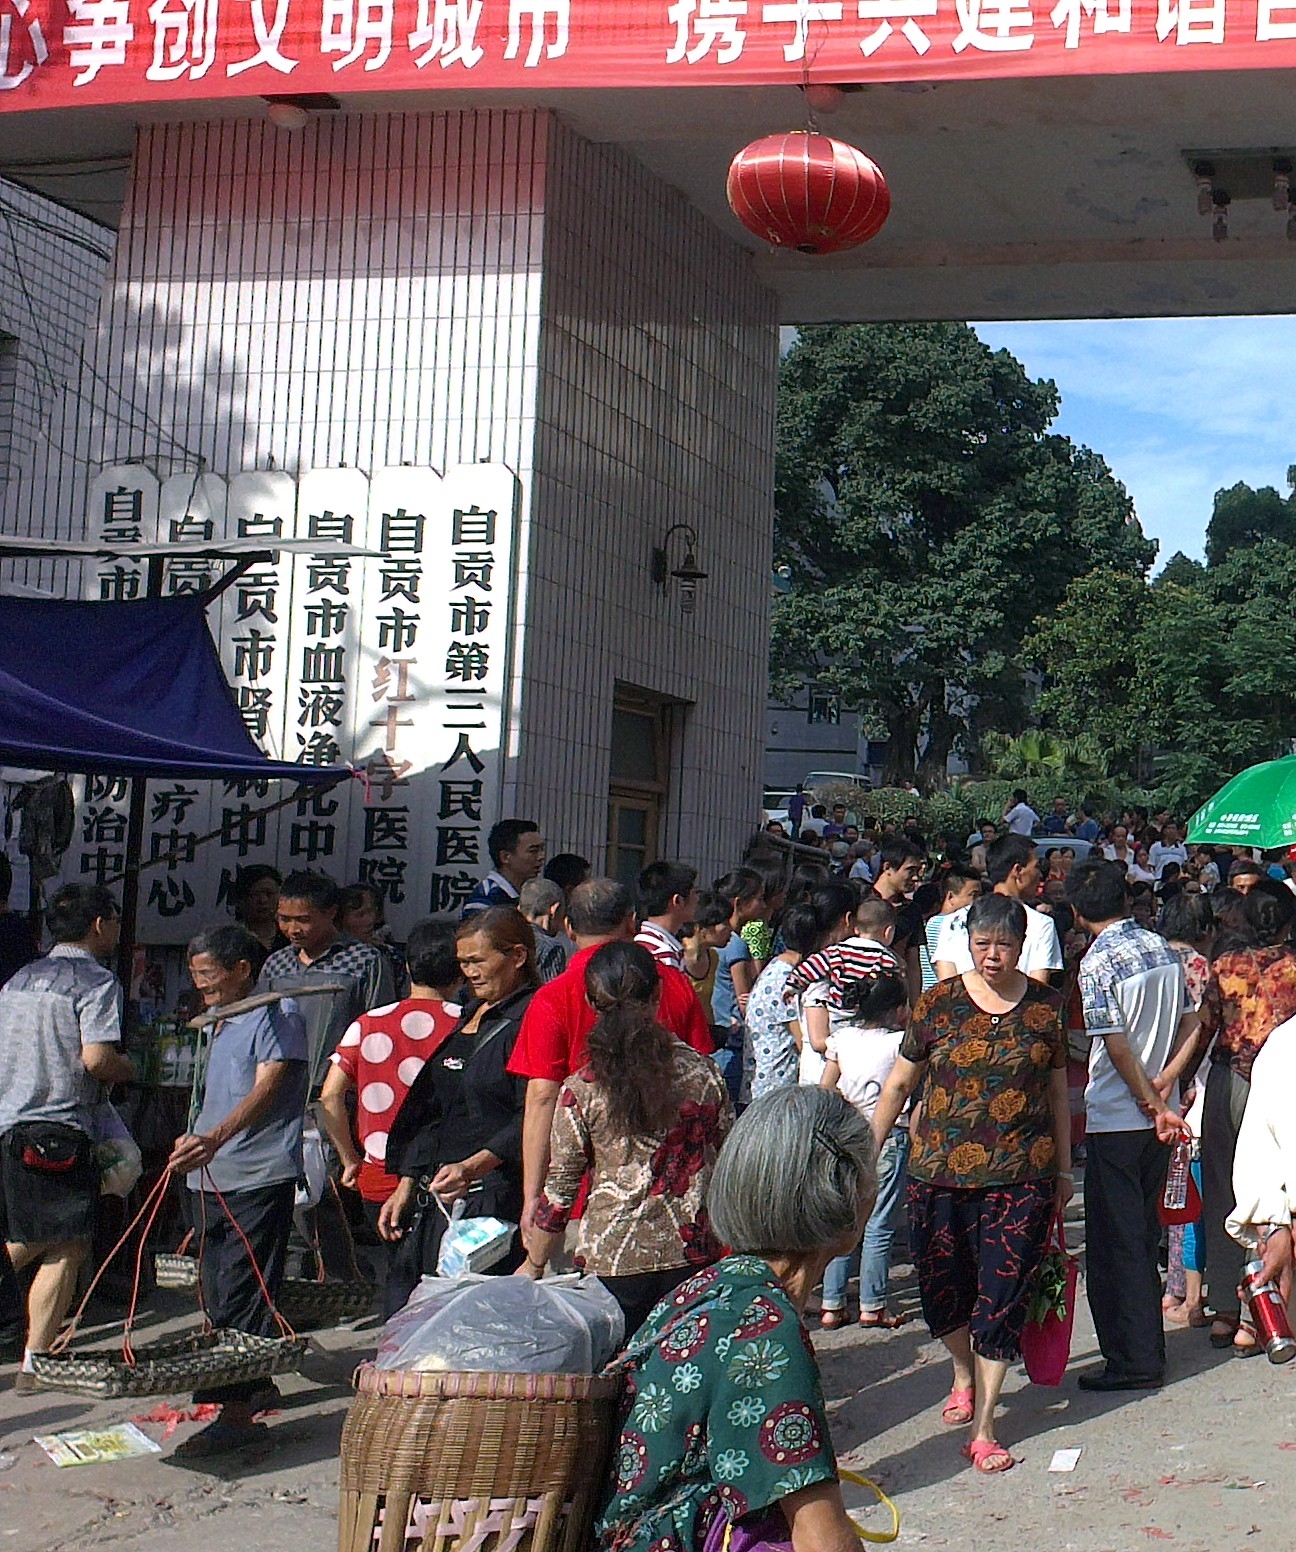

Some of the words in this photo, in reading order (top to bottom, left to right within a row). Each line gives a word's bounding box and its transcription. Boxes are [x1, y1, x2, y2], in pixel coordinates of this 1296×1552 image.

[289, 511, 353, 882] 自贡市血液净化中
[357, 508, 427, 904] 自贡市红十字医院
[430, 505, 497, 914] 自贡市第三人民医院
